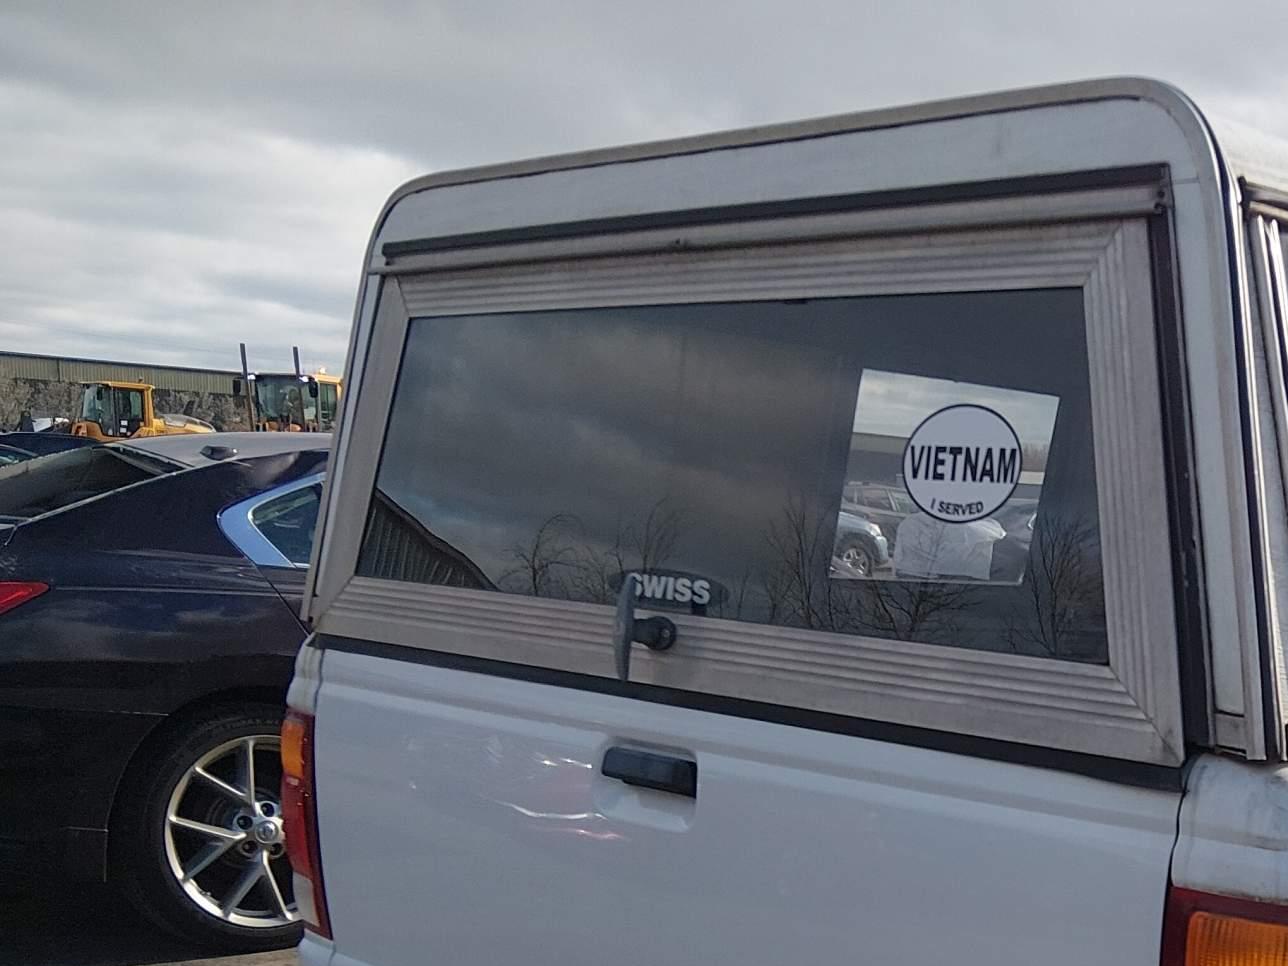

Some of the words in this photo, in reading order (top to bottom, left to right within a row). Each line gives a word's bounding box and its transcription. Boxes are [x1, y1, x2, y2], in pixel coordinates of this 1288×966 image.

[910, 445, 1017, 484] VIETNAM
[930, 498, 936, 511] I
[938, 500, 984, 516] SERVED
